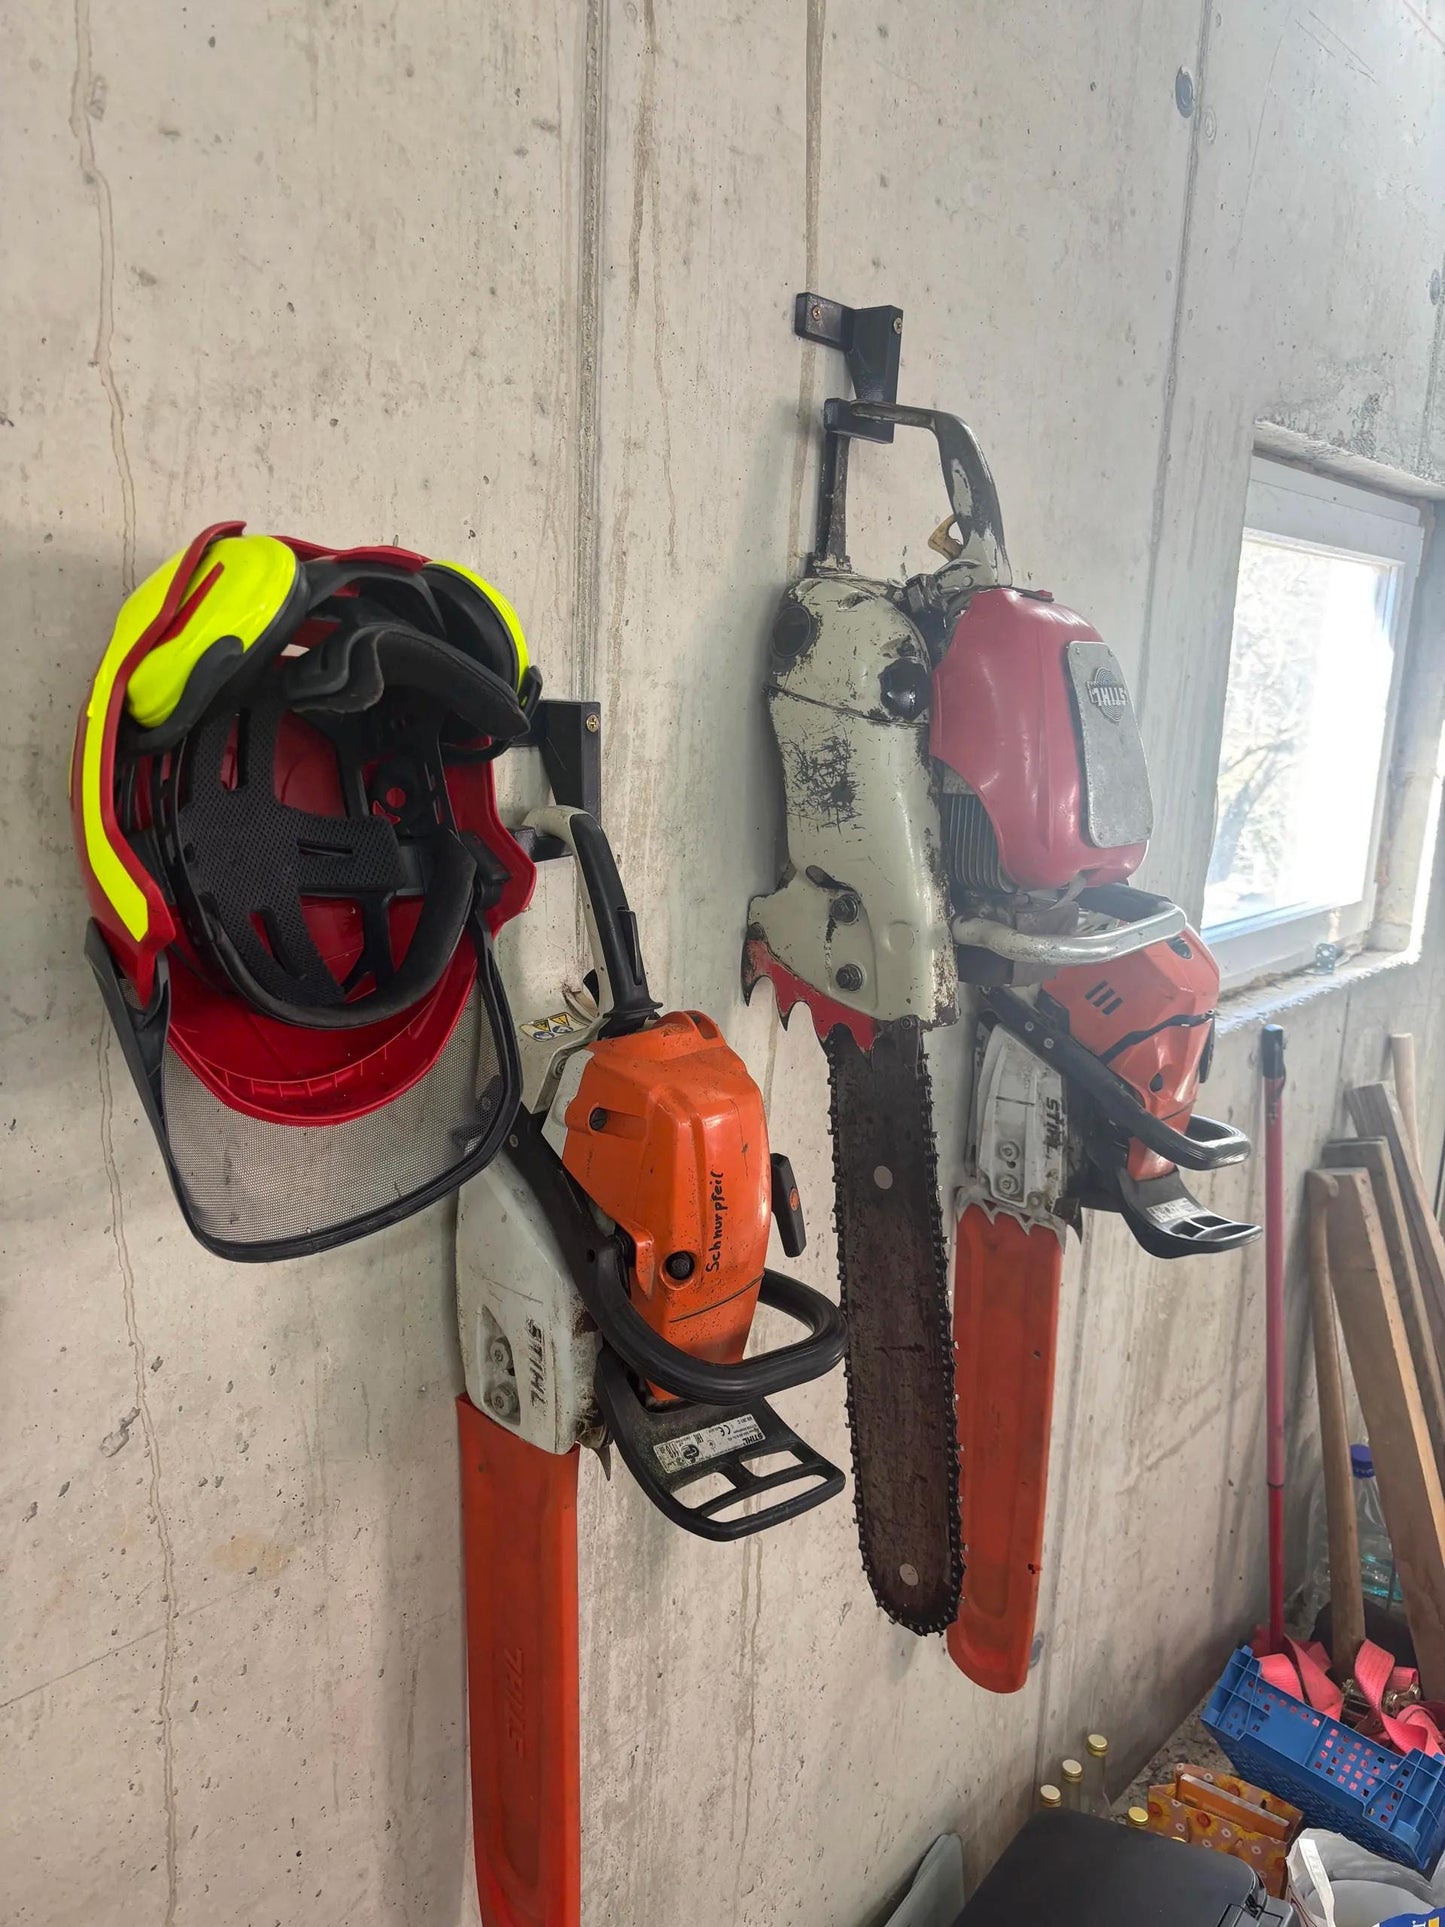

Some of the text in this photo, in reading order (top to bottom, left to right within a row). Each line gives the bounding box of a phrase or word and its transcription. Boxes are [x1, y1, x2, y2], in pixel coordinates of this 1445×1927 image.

[1091, 687, 1129, 707] STIHL
[1044, 1096, 1063, 1159] STIHL
[705, 1170, 728, 1273] Schnurpfeil
[525, 1316, 547, 1409] STIHL
[741, 1432, 763, 1446] STIHL
